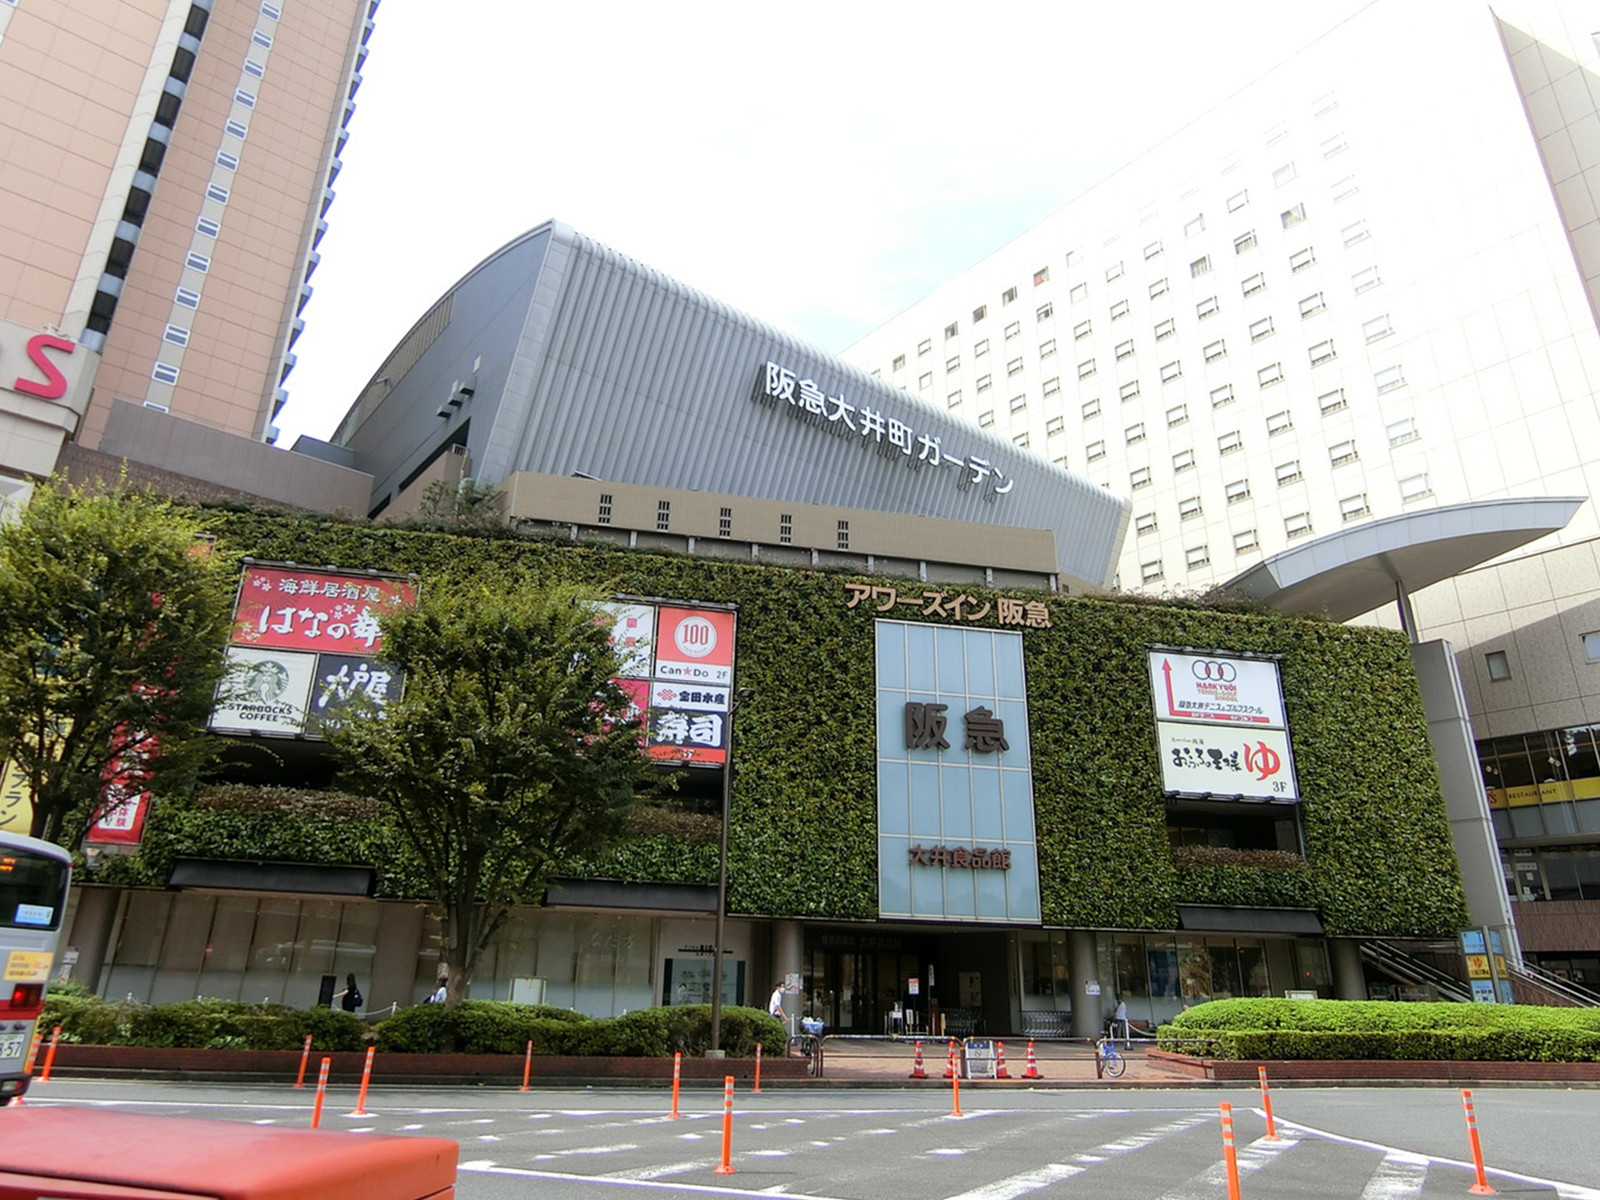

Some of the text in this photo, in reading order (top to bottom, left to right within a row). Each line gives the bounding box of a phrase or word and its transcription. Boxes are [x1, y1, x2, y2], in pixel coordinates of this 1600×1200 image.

[765, 361, 1014, 494] 阪急大井町ガーデン
[278, 578, 382, 603] 海鮮居酒屋
[258, 605, 383, 648] はなの舞
[681, 623, 709, 646] 100
[318, 662, 392, 708] 大戸屋
[716, 670, 728, 679] 2F
[227, 702, 293, 715] STARBUCKS
[239, 711, 279, 722] COFFEE
[904, 702, 1010, 752] 阪急
[1243, 741, 1281, 781] ゆ
[1272, 781, 1287, 793] 3F
[908, 844, 1012, 870] 大井食品館
